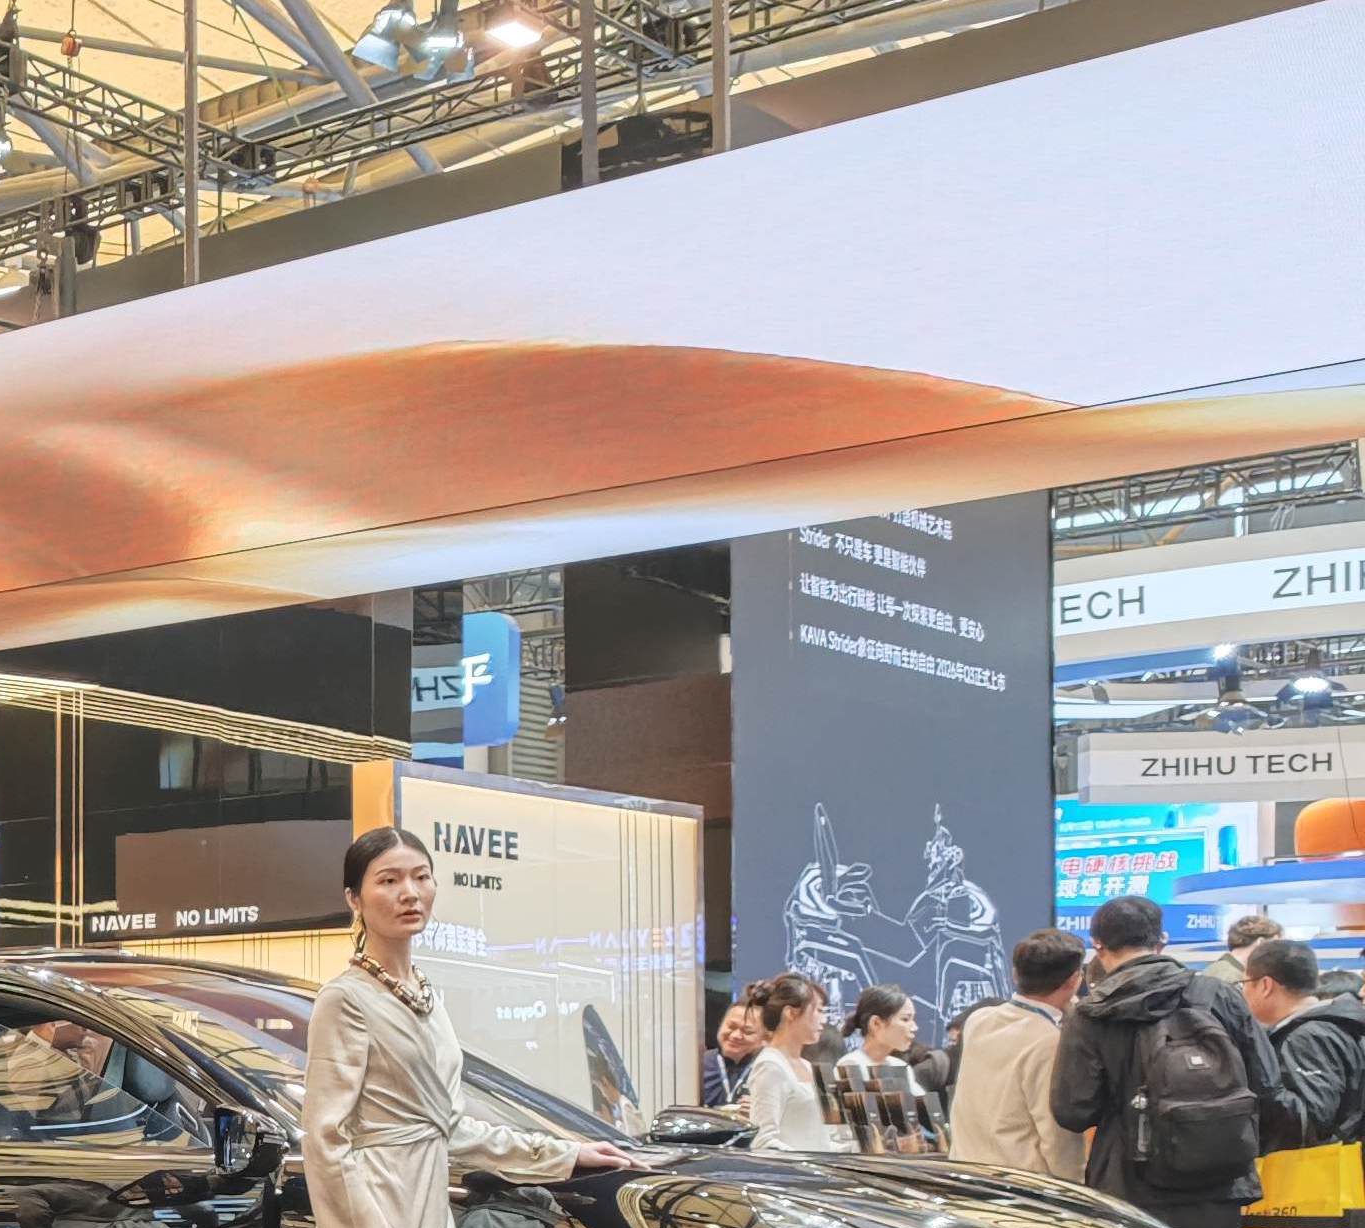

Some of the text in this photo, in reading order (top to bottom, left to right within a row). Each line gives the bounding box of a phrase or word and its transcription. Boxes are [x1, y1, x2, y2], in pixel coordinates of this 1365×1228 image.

[799, 526, 832, 549] Strider
[800, 624, 829, 649] KAVA
[1140, 752, 1333, 777] ZHIHU TECH
[433, 821, 519, 860] NAVEE
[453, 871, 502, 891] NO LIMITS
[91, 905, 259, 933] NAVEE NO LIMITS
